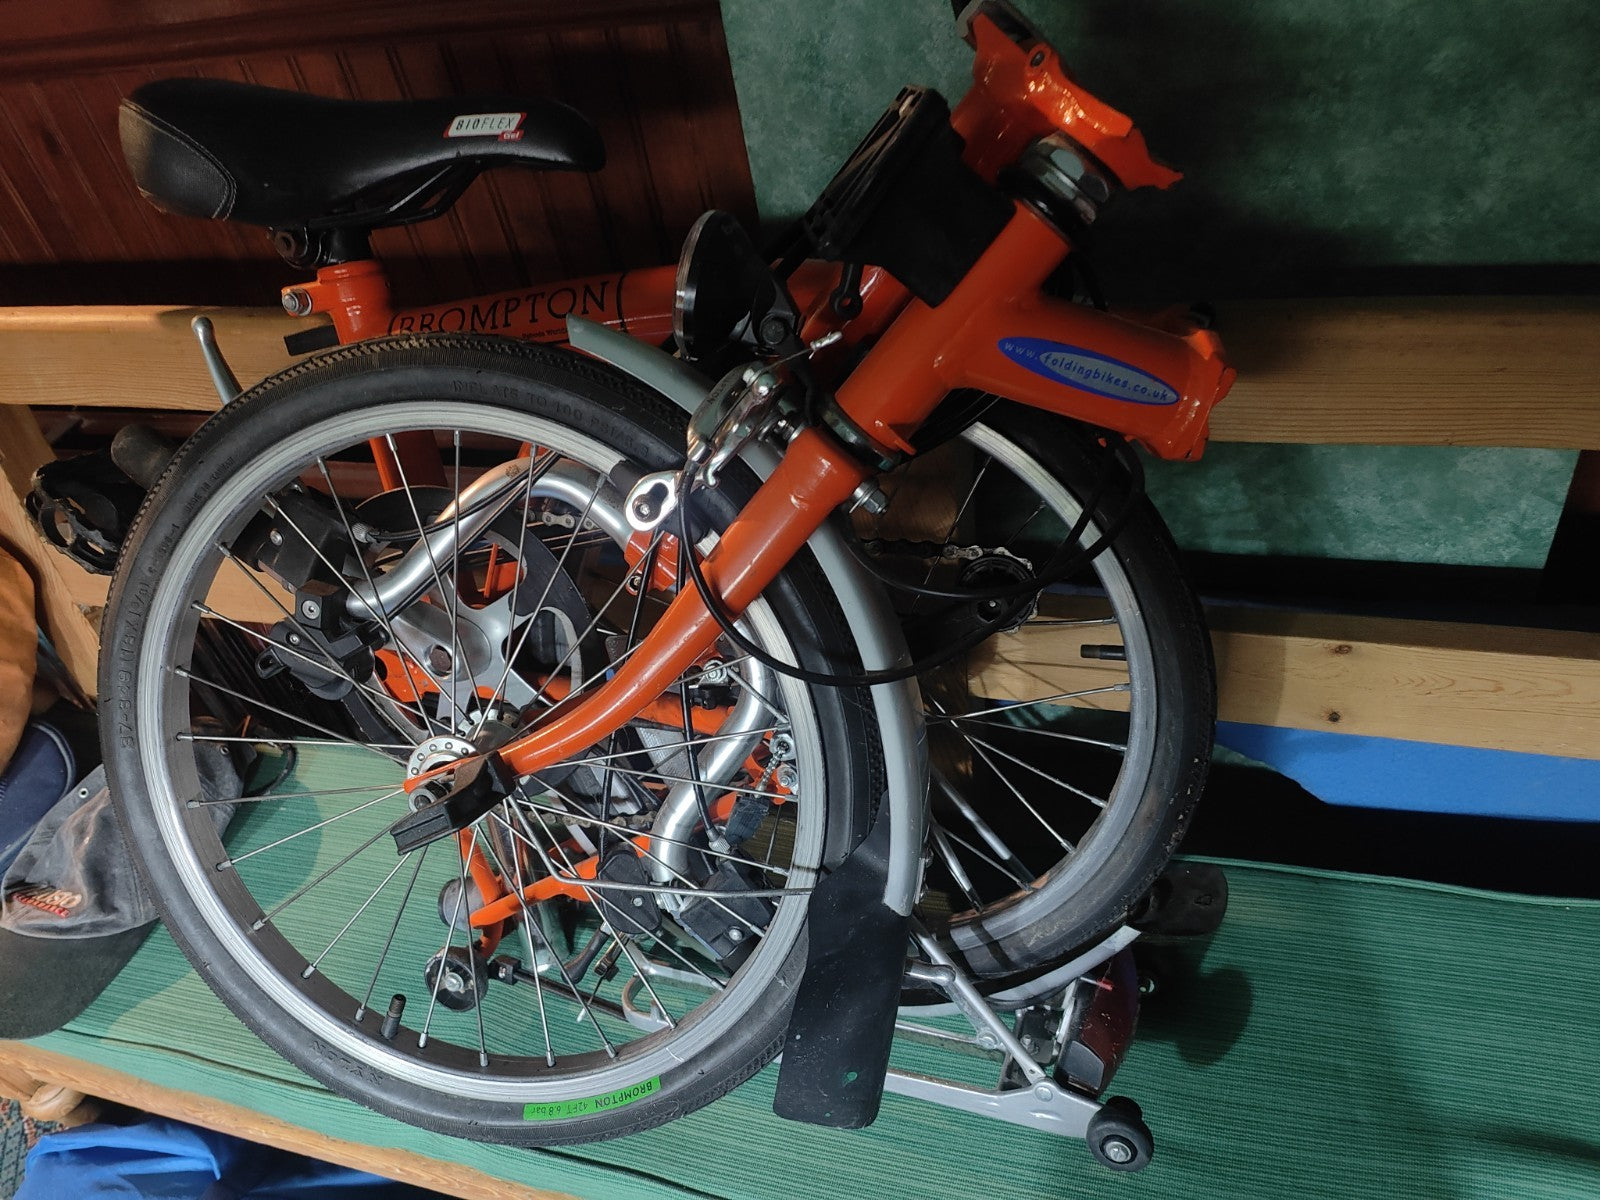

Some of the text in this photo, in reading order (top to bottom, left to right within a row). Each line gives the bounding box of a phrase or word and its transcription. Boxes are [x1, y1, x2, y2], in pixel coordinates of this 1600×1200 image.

[456, 117, 515, 131] BIOFLEX
[398, 280, 610, 334] BROMPTON
[594, 1081, 653, 1109] BROMPTON
